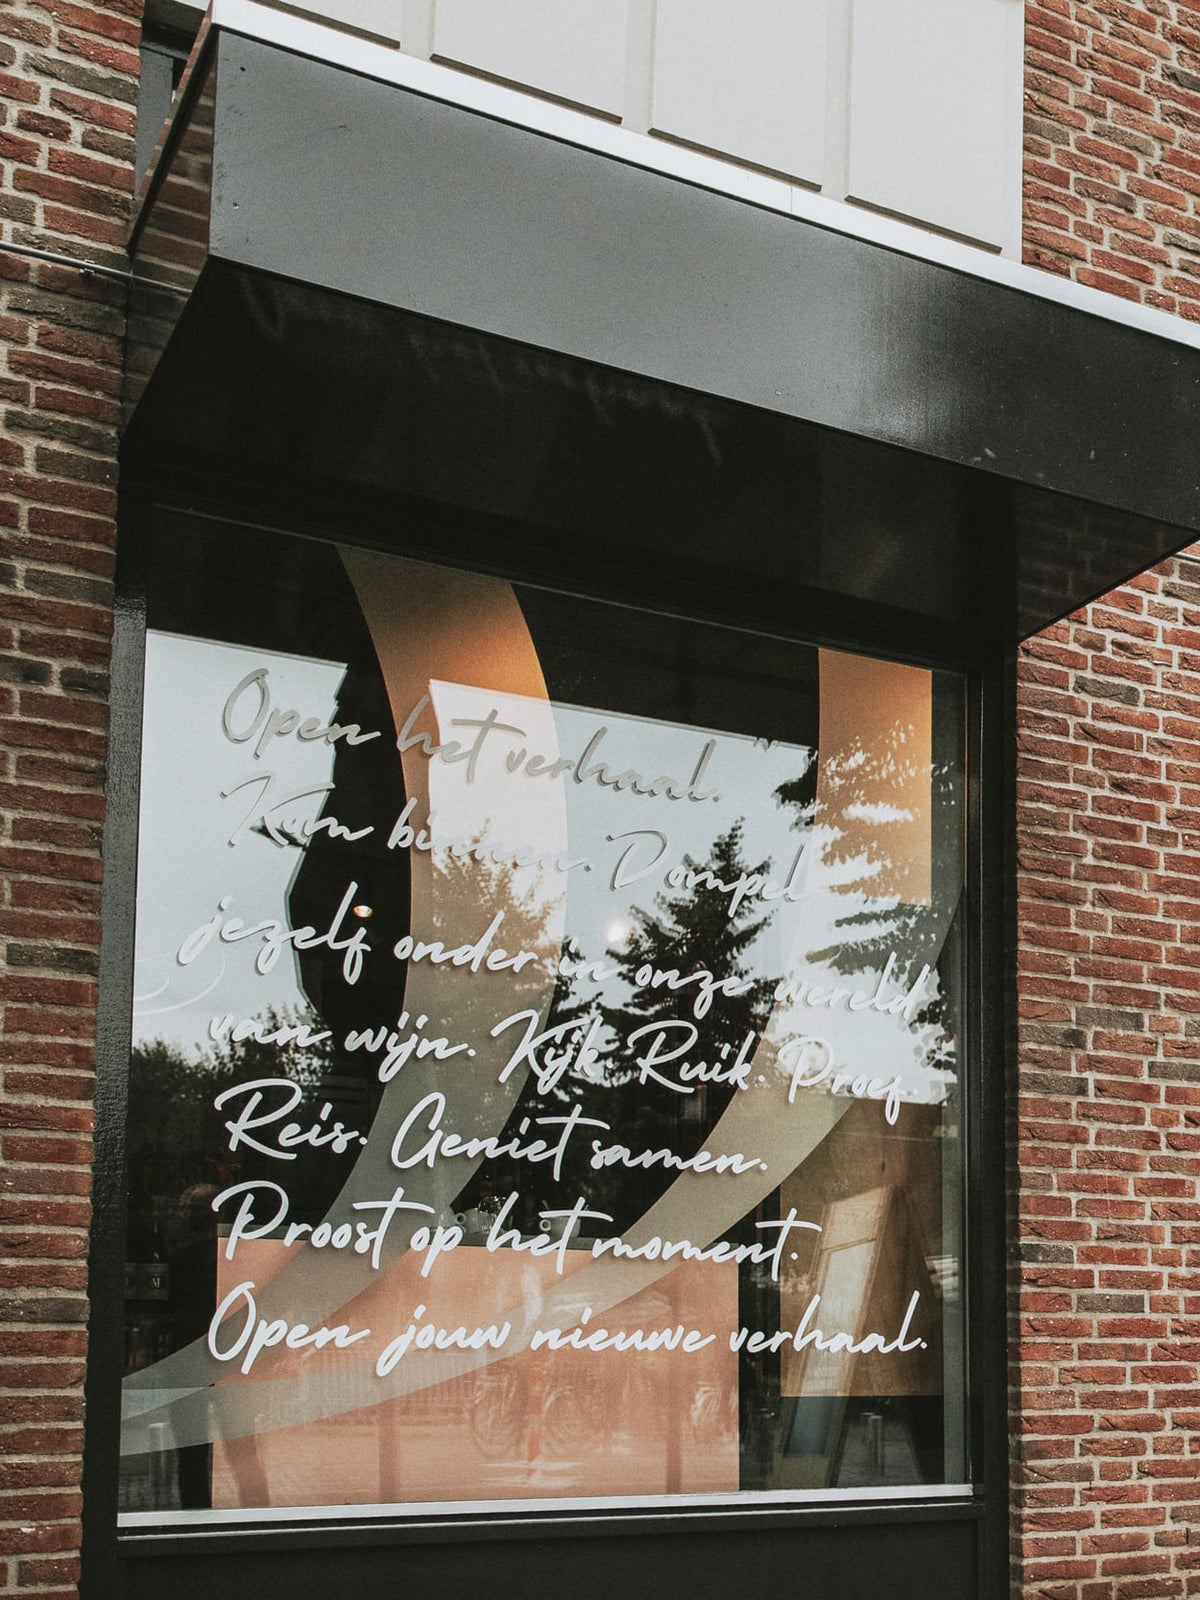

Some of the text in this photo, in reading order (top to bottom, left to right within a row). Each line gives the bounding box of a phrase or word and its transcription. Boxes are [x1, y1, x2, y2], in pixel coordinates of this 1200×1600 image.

[222, 668, 721, 802] Open het verhaal.
[606, 829, 806, 918] Dompel
[177, 881, 931, 1020] jezelf onder in onze wereld
[208, 1013, 333, 1047] van
[344, 1011, 477, 1083] wijn.
[626, 1019, 767, 1094] Ruik.
[214, 1078, 769, 1182] Reis. Geniet samen.
[211, 1180, 823, 1282] Proost op het moment.
[208, 1281, 928, 1377] Open jouw nieuwe verhaal.
